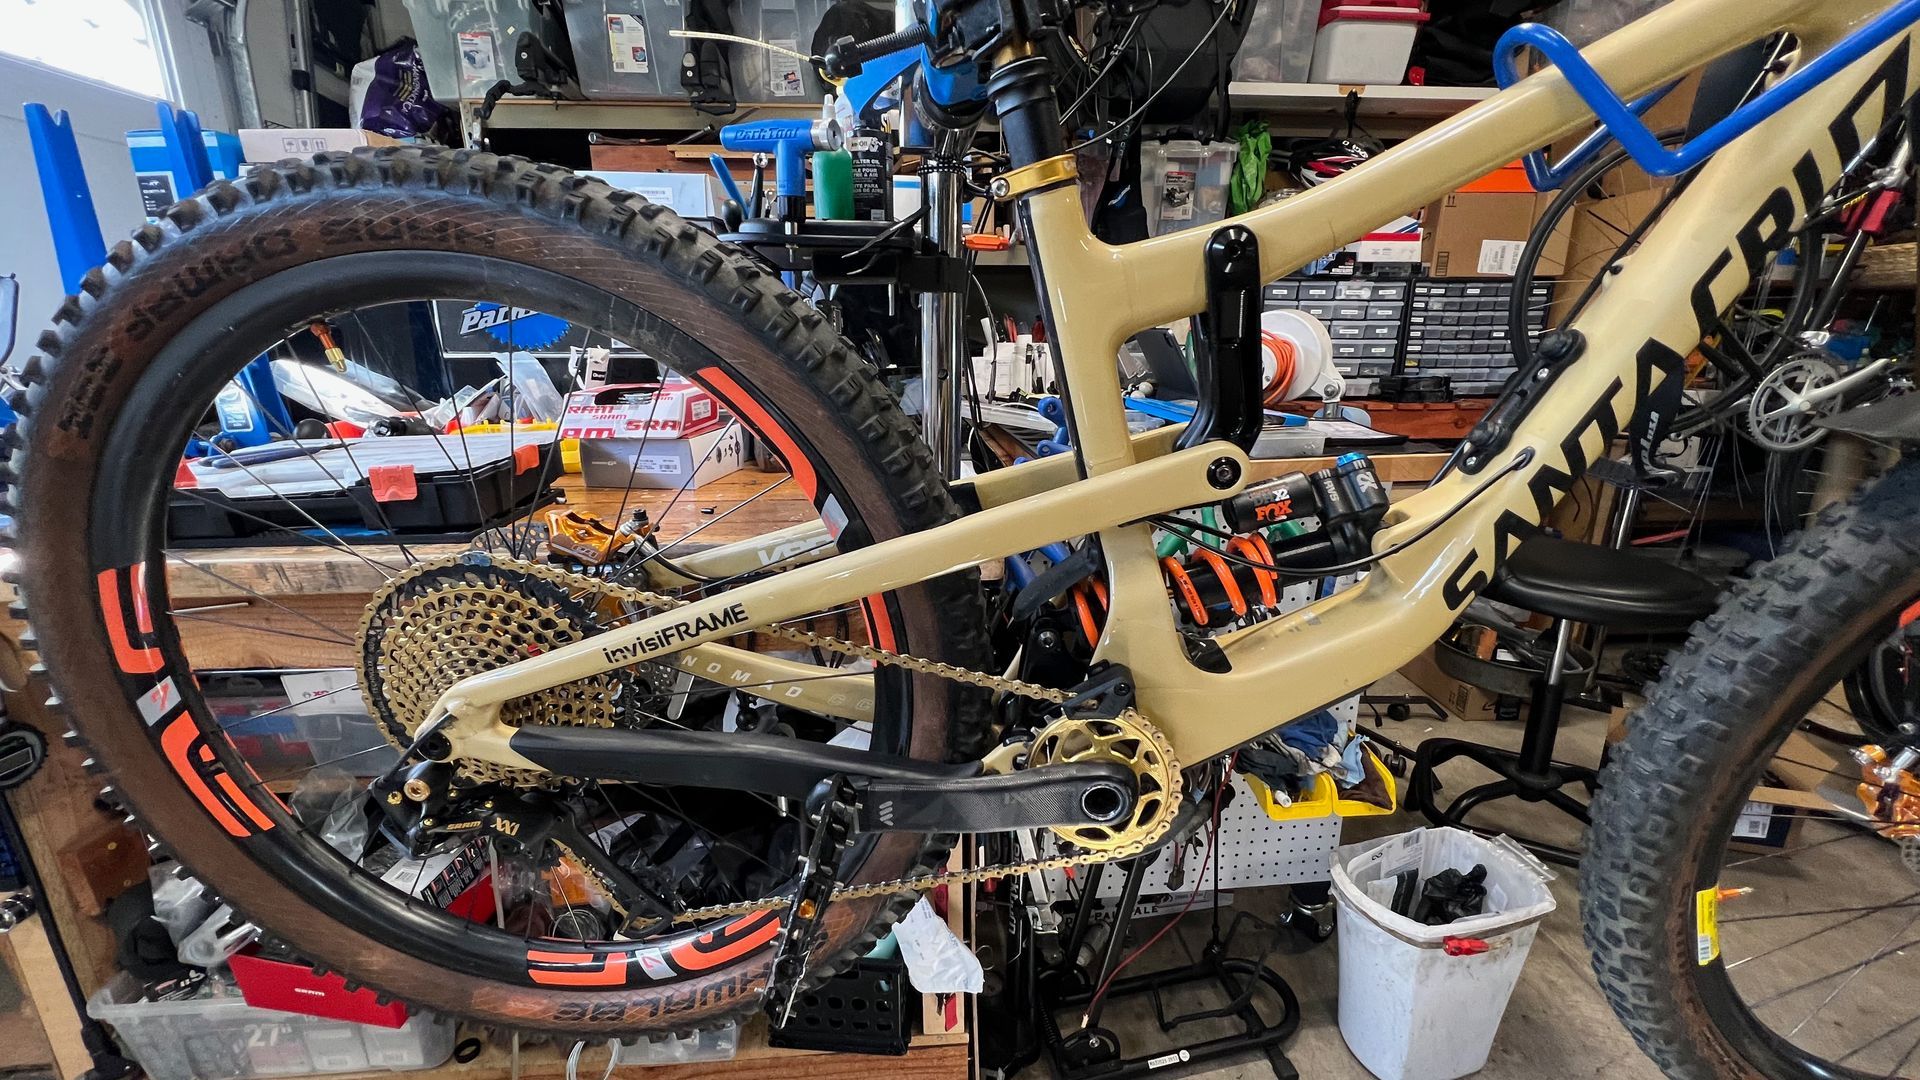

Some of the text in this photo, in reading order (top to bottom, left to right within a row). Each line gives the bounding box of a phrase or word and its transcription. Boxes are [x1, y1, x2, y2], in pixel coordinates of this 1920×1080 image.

[625, 419, 681, 431] SRA
[1443, 337, 1685, 612] SANTA
[1254, 500, 1294, 522] FOX
[602, 602, 749, 664] invisiFRAME
[681, 654, 804, 698] NOMAD
[447, 820, 482, 831] SRAM
